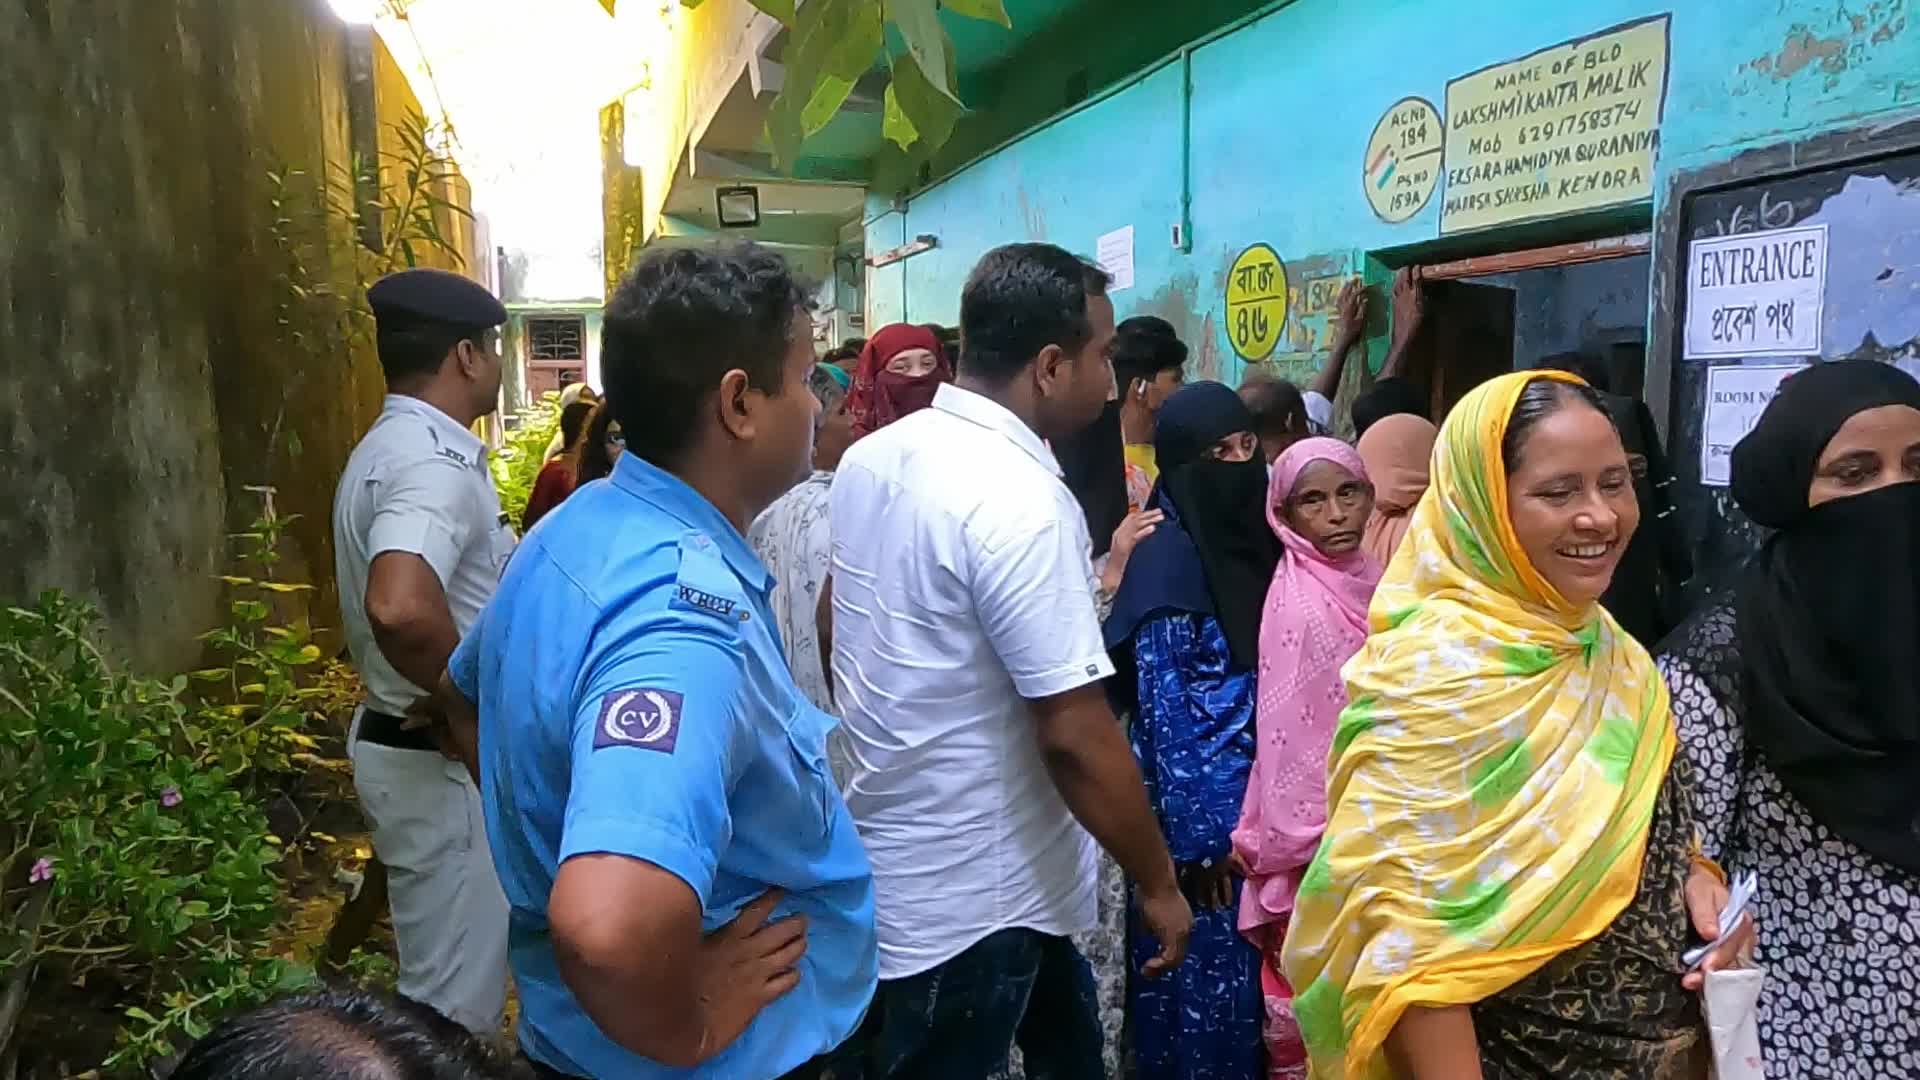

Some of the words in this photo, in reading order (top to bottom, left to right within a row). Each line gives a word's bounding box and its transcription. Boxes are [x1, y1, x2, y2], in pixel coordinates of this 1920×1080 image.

[1494, 66, 1541, 90] NAME
[1552, 55, 1578, 76] OF
[1584, 43, 1621, 70] BLO
[1400, 122, 1427, 149] 184
[1468, 135, 1502, 155] Mob
[1518, 99, 1641, 147] 6291758374
[1700, 239, 1816, 288] ENTRANCE
[1711, 303, 1757, 343] প্রবেশ
[1766, 299, 1795, 339] পথ
[1714, 391, 1755, 404] ROOM
[620, 709, 659, 729] CV
